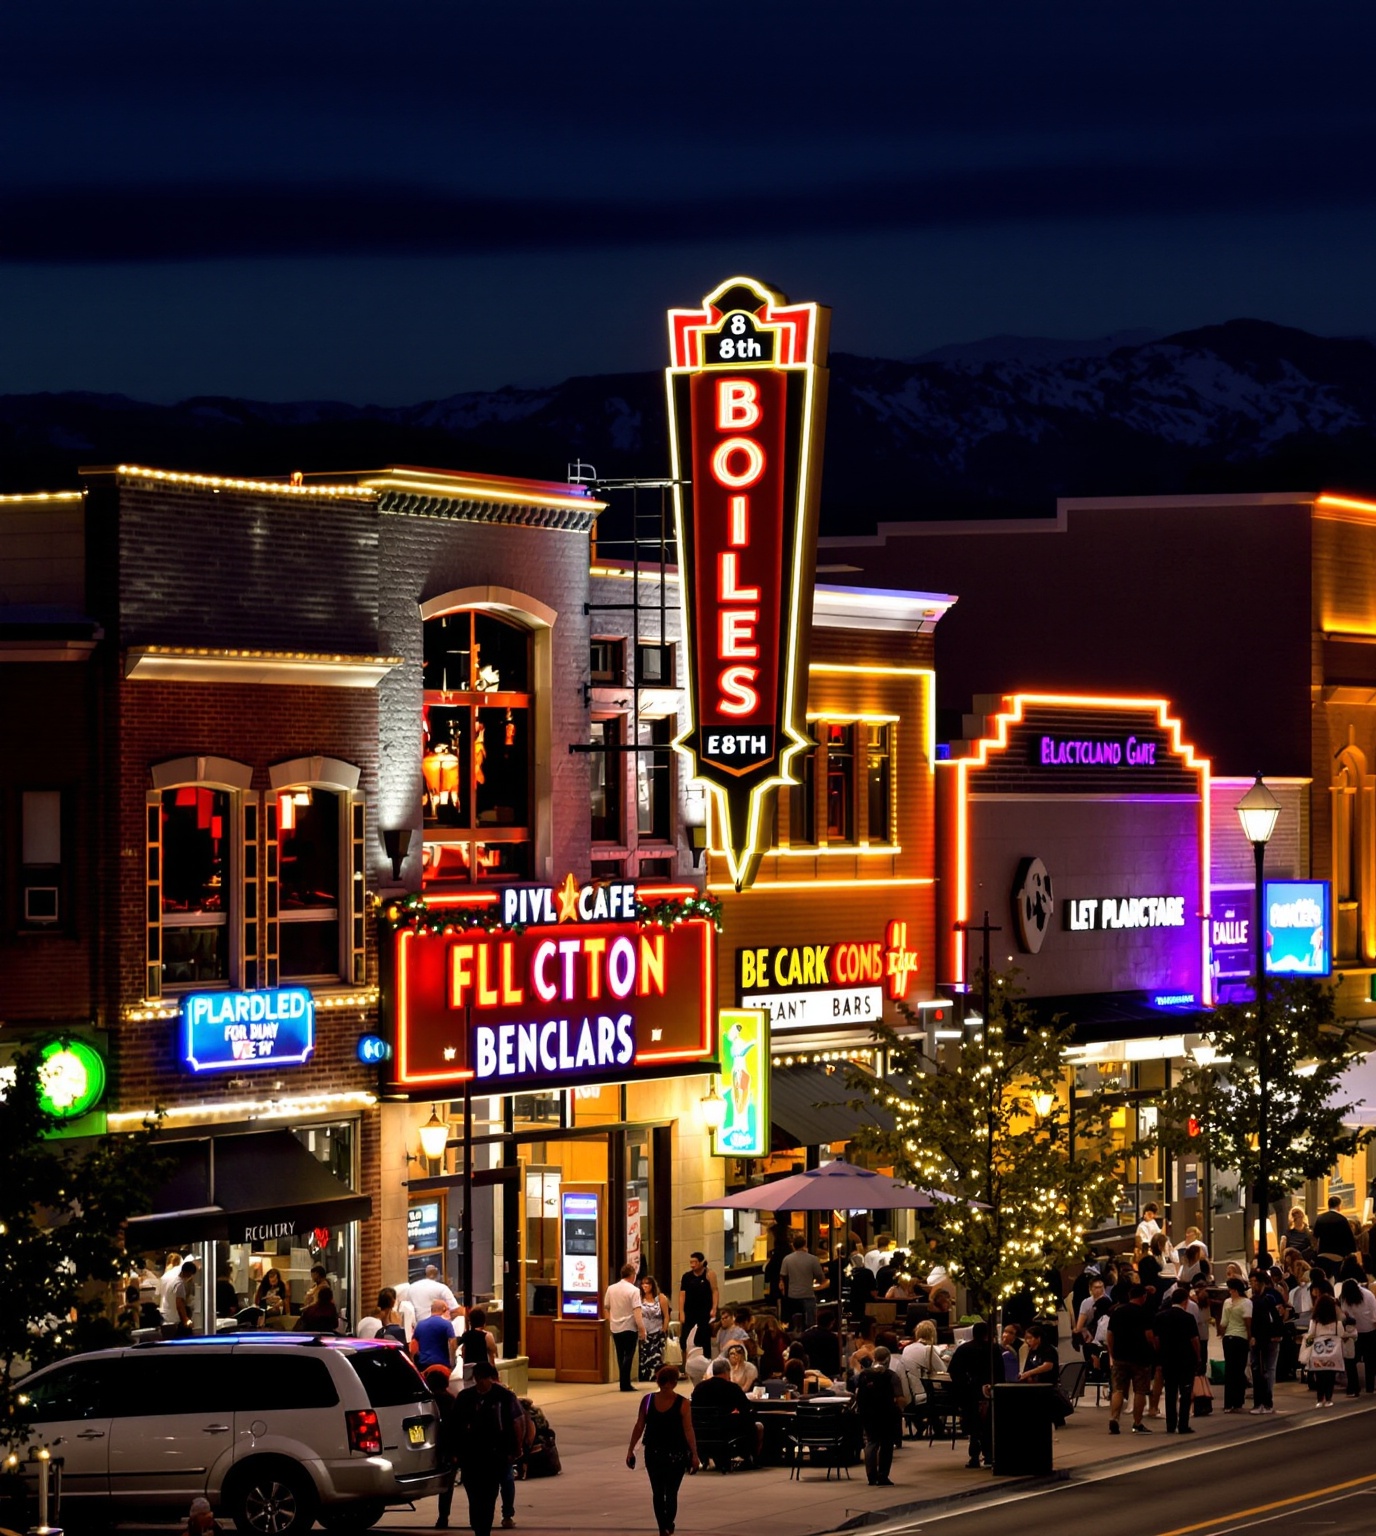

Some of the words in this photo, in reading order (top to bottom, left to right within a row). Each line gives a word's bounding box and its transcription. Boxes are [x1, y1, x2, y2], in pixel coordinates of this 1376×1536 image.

[730, 315, 747, 335] 8
[719, 338, 762, 359] 8th
[713, 379, 763, 716] BOILES
[707, 735, 767, 755] E8TH
[578, 884, 636, 921] CAFE
[1070, 899, 1098, 931] LET
[742, 949, 770, 989] BE
[774, 945, 830, 987] CARK
[832, 995, 871, 1017] BARS
[476, 1014, 634, 1078] BENCLARS
